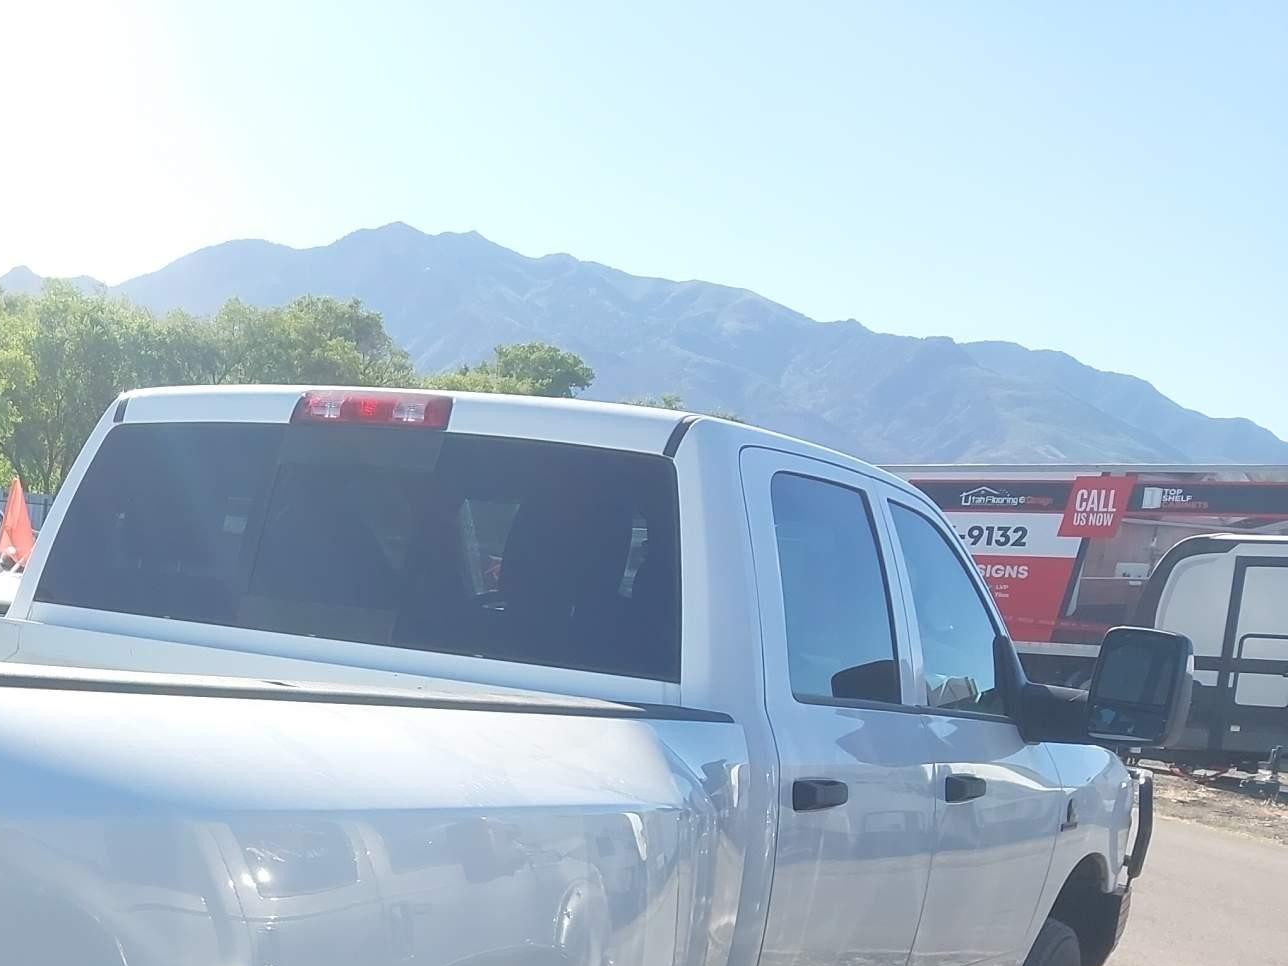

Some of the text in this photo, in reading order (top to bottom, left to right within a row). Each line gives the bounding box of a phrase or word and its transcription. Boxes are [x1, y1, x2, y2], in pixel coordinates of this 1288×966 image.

[1163, 488, 1183, 496] TOP
[961, 494, 985, 506] Utah
[985, 495, 1018, 506] Flooring
[1075, 489, 1116, 511] CALL
[1072, 512, 1114, 526] US NOW
[953, 524, 1028, 548] -9132
